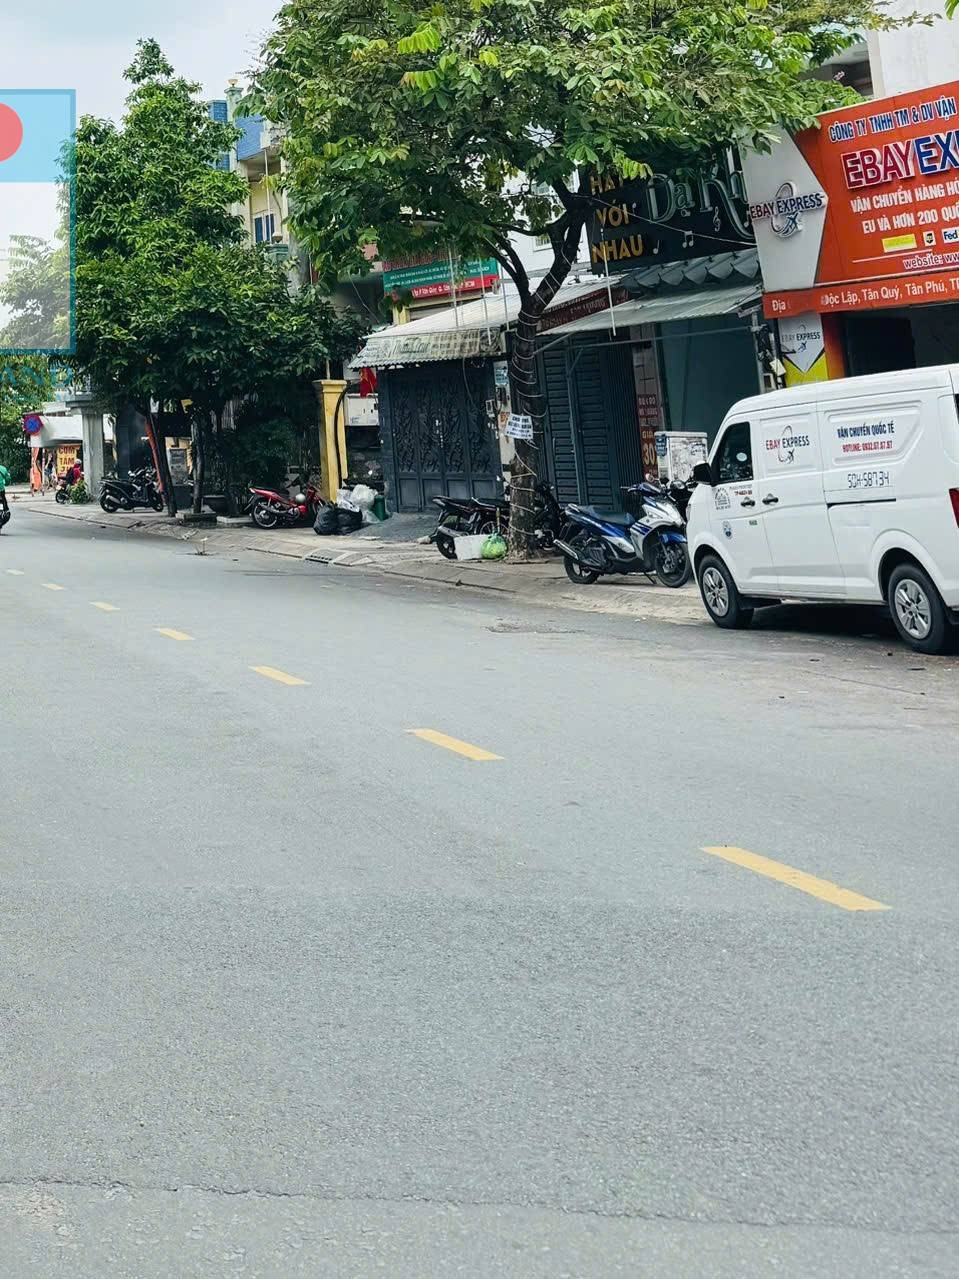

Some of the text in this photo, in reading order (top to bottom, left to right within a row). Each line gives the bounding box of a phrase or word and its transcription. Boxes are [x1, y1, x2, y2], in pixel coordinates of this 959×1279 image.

[828, 95, 957, 142] CÔNG TY TNHH TM & DV VẬN
[749, 193, 823, 219] EBAY EXPRESS
[850, 196, 871, 215] VẬN
[873, 186, 913, 208] CHUYỂN
[914, 183, 945, 201] HÀNG
[862, 219, 876, 234] EU
[877, 214, 891, 231] VÀ
[892, 212, 916, 229] HƠN
[917, 209, 939, 226] 200
[943, 229, 959, 240] Fed
[592, 234, 644, 264] NHAU
[903, 253, 943, 269] website:
[772, 300, 786, 313] Địa
[841, 290, 861, 305] Lập,
[861, 288, 879, 301] Tân
[905, 283, 924, 296] Tân
[925, 280, 948, 293] Phú,
[765, 435, 810, 451] EBAY EXPRESS
